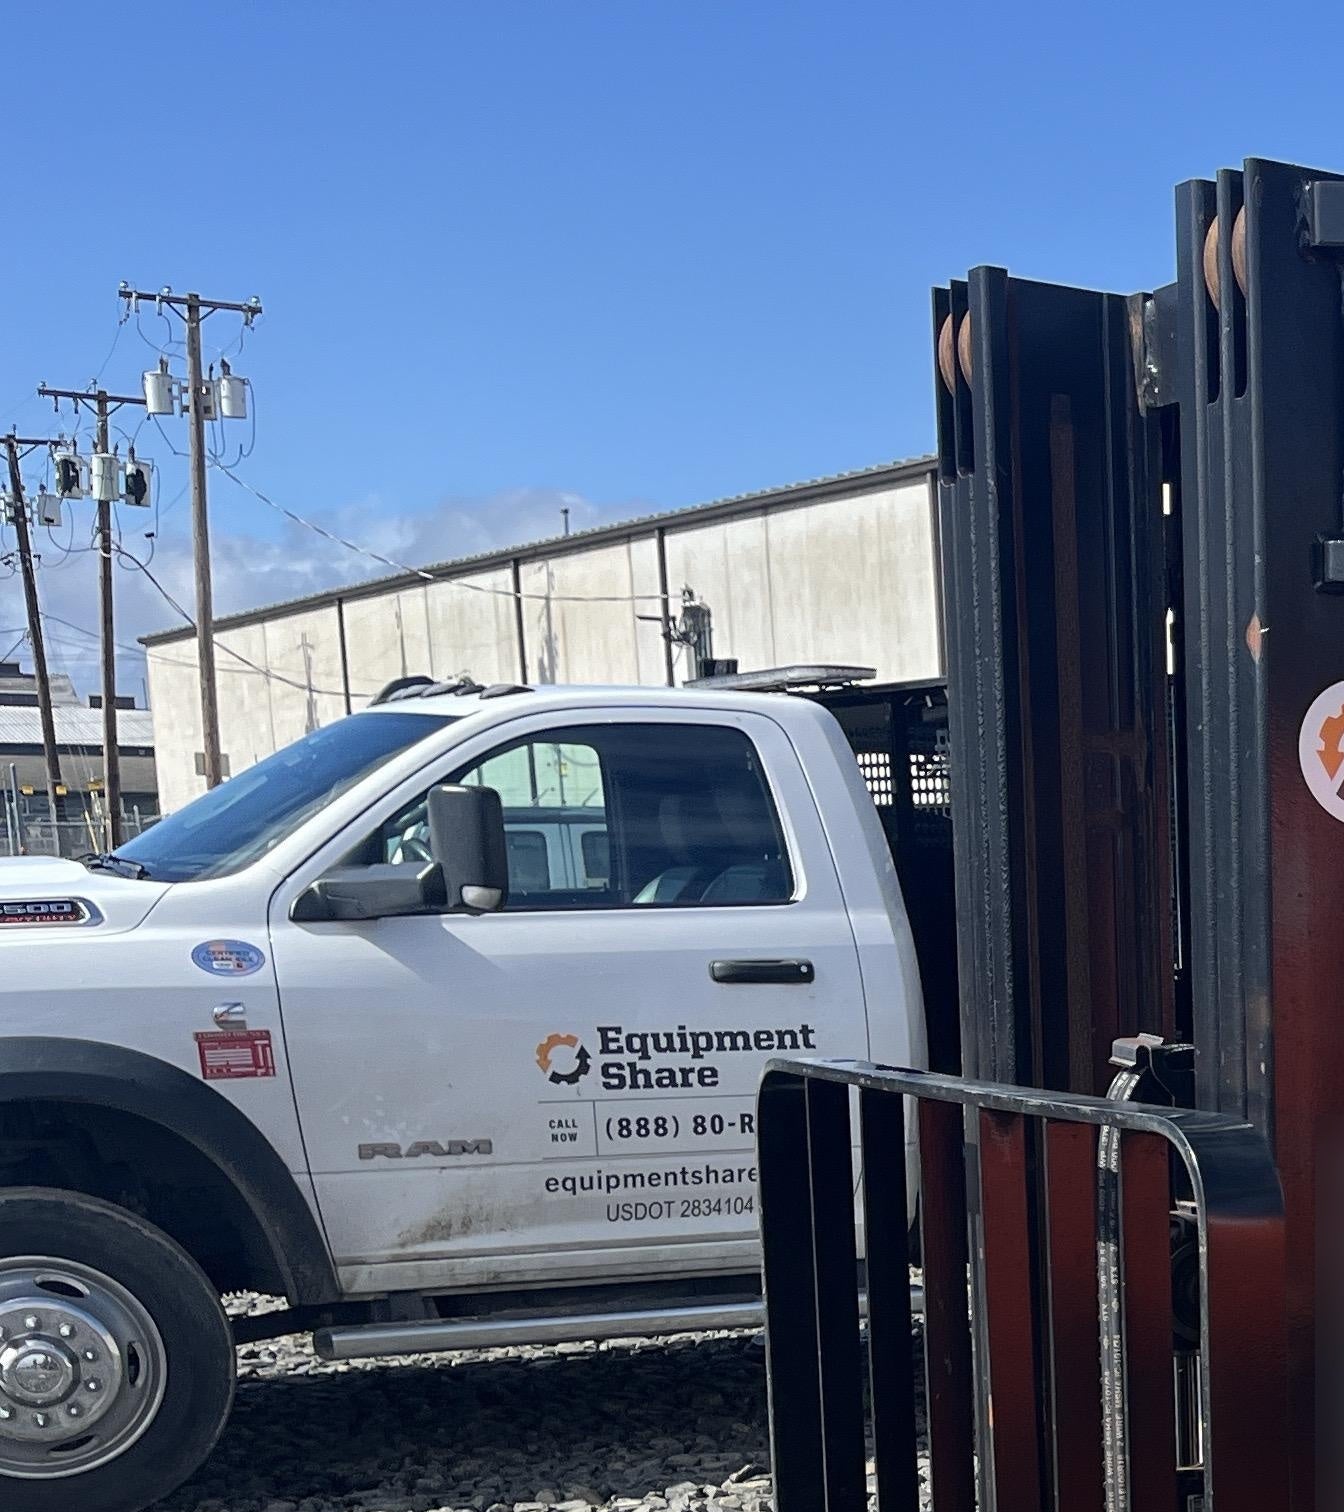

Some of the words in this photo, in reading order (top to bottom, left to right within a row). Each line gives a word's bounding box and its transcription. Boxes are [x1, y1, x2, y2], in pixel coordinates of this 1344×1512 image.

[597, 1024, 816, 1060] Equipment
[600, 1061, 719, 1091] Share
[548, 1118, 578, 1129] CALL
[605, 1115, 680, 1141] (888)
[358, 1139, 493, 1160] RAM
[551, 1131, 578, 1143] NOW
[606, 1201, 675, 1222] USDOT
[680, 1196, 754, 1219] 2834104
